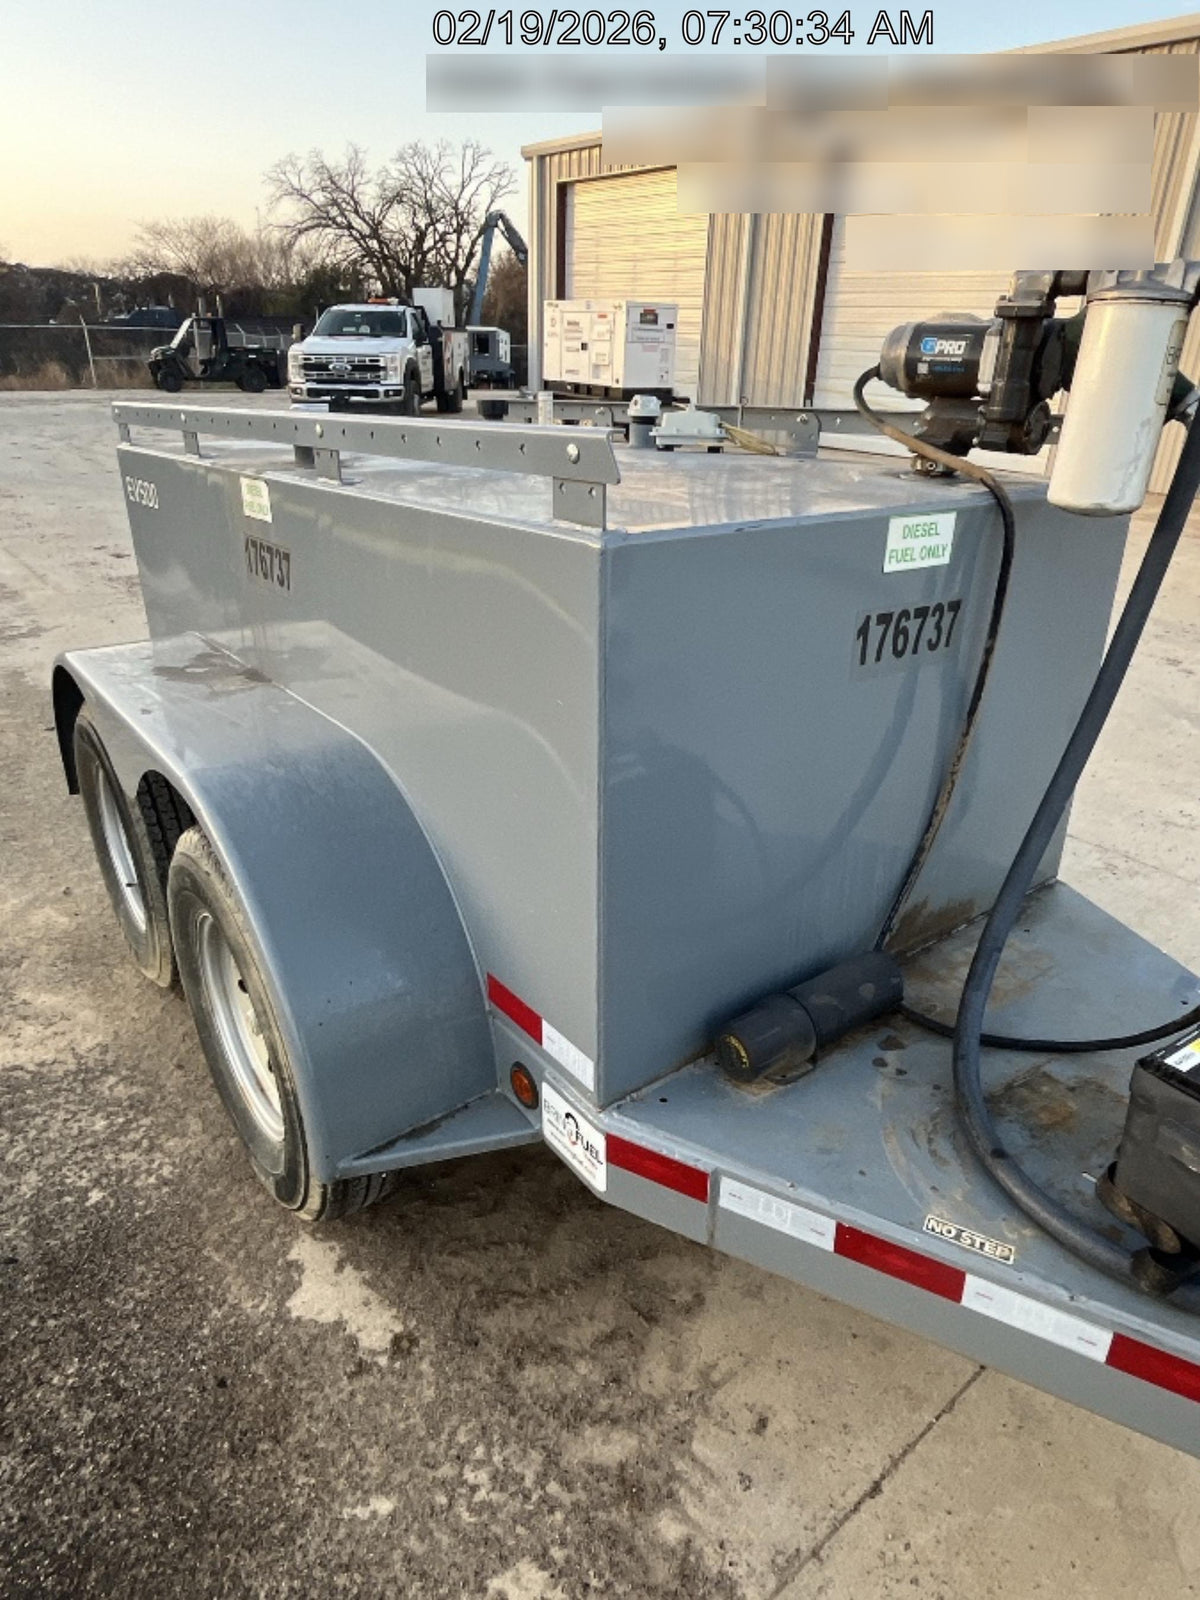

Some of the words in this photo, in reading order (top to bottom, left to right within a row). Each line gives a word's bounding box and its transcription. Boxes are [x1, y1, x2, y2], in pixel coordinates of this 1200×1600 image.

[902, 522, 940, 540] DIESEL
[244, 535, 291, 591] 176737
[888, 545, 917, 564] FUEL
[920, 543, 949, 561] ONLY
[856, 599, 962, 666] 176737
[927, 1218, 957, 1239] NO
[960, 1231, 1012, 1259] STEP
